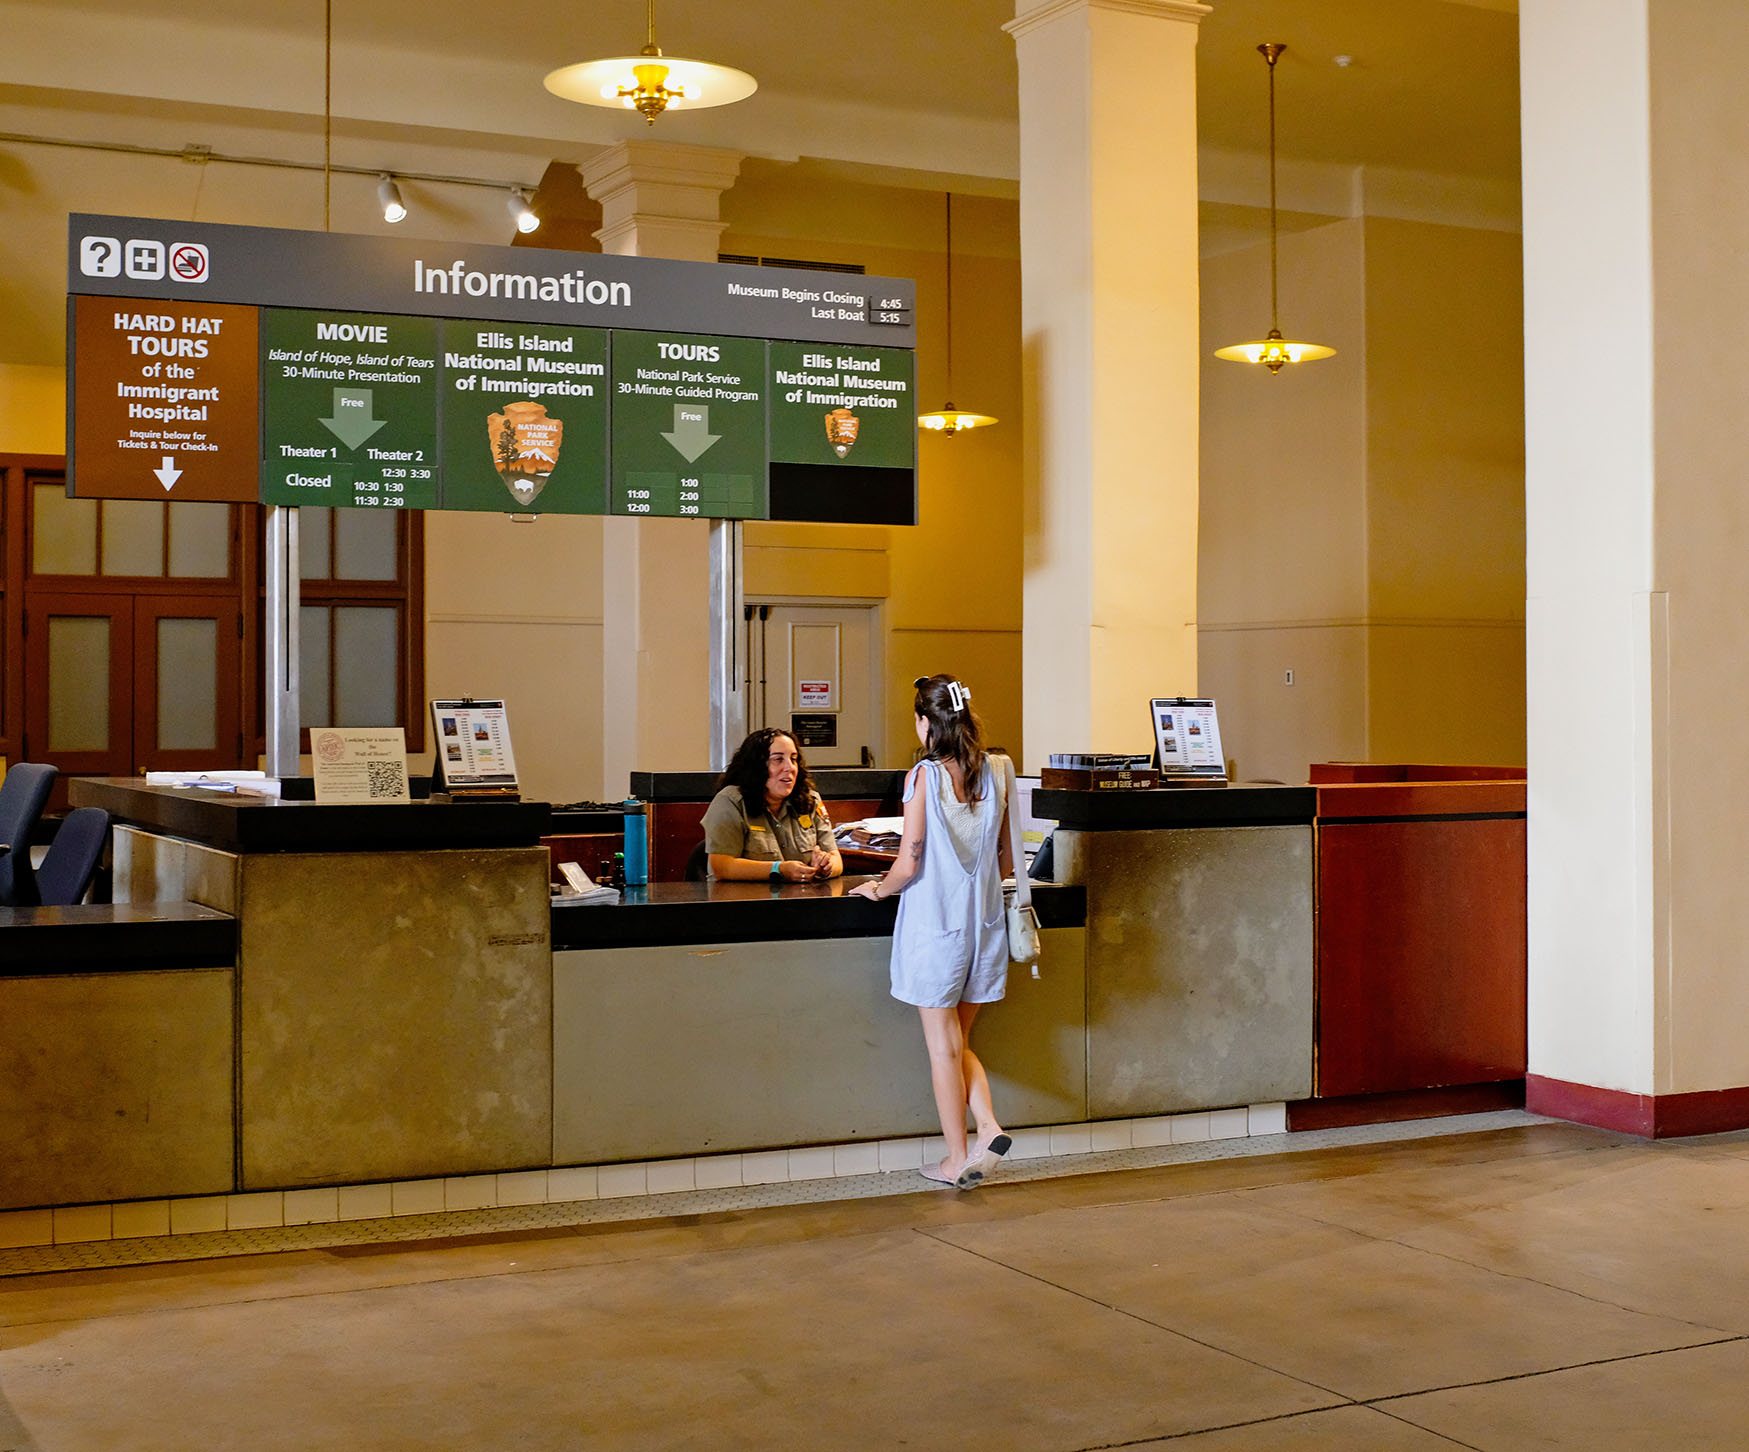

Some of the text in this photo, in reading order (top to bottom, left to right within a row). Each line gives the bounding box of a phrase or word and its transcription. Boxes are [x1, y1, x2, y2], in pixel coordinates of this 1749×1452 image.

[415, 260, 631, 306] Information
[728, 284, 901, 308] Museum Begins Closing 4:45
[812, 307, 900, 323] Last Boat 5:15
[115, 313, 223, 334] HARD HAT
[317, 323, 387, 343] MOVIE
[128, 336, 208, 358] TOURS
[477, 333, 573, 354] Ellis Island
[269, 349, 434, 368] Island of Hope, Island of Tears
[658, 343, 720, 362] TOURS
[142, 362, 194, 379] of the
[445, 353, 604, 377] National Museum
[803, 354, 880, 371] Ellis Island
[283, 366, 420, 383] 30-Minute Presentation
[637, 369, 740, 384] National Park Service
[776, 371, 906, 392] National Museum
[118, 382, 219, 403] Immigrant
[456, 375, 593, 397] of Immigration
[618, 383, 758, 402] 30-Minute Guided Program
[341, 398, 364, 407] Free
[786, 389, 897, 409] of Immigration
[129, 404, 207, 423] Hospital
[681, 412, 701, 421] Free
[130, 430, 206, 440] Inquire below for
[518, 424, 558, 432] NATIONAL
[118, 440, 218, 451] Tickets & Tour Check-In
[280, 445, 336, 458] Theater 1
[367, 449, 423, 461] Theater 2
[286, 473, 331, 487] Closed
[382, 468, 430, 478] 12:30 3:30
[354, 482, 403, 492] 10:30 1:30
[681, 479, 698, 487] 1:00
[355, 496, 403, 506] 11:30 2:30
[628, 490, 649, 498] 11:00
[680, 492, 699, 500] 2:00
[627, 504, 650, 512] 12:00
[680, 506, 698, 514] 3:00
[1099, 780, 1118, 788] MUSEUM
[1119, 780, 1132, 788] GUIDE
